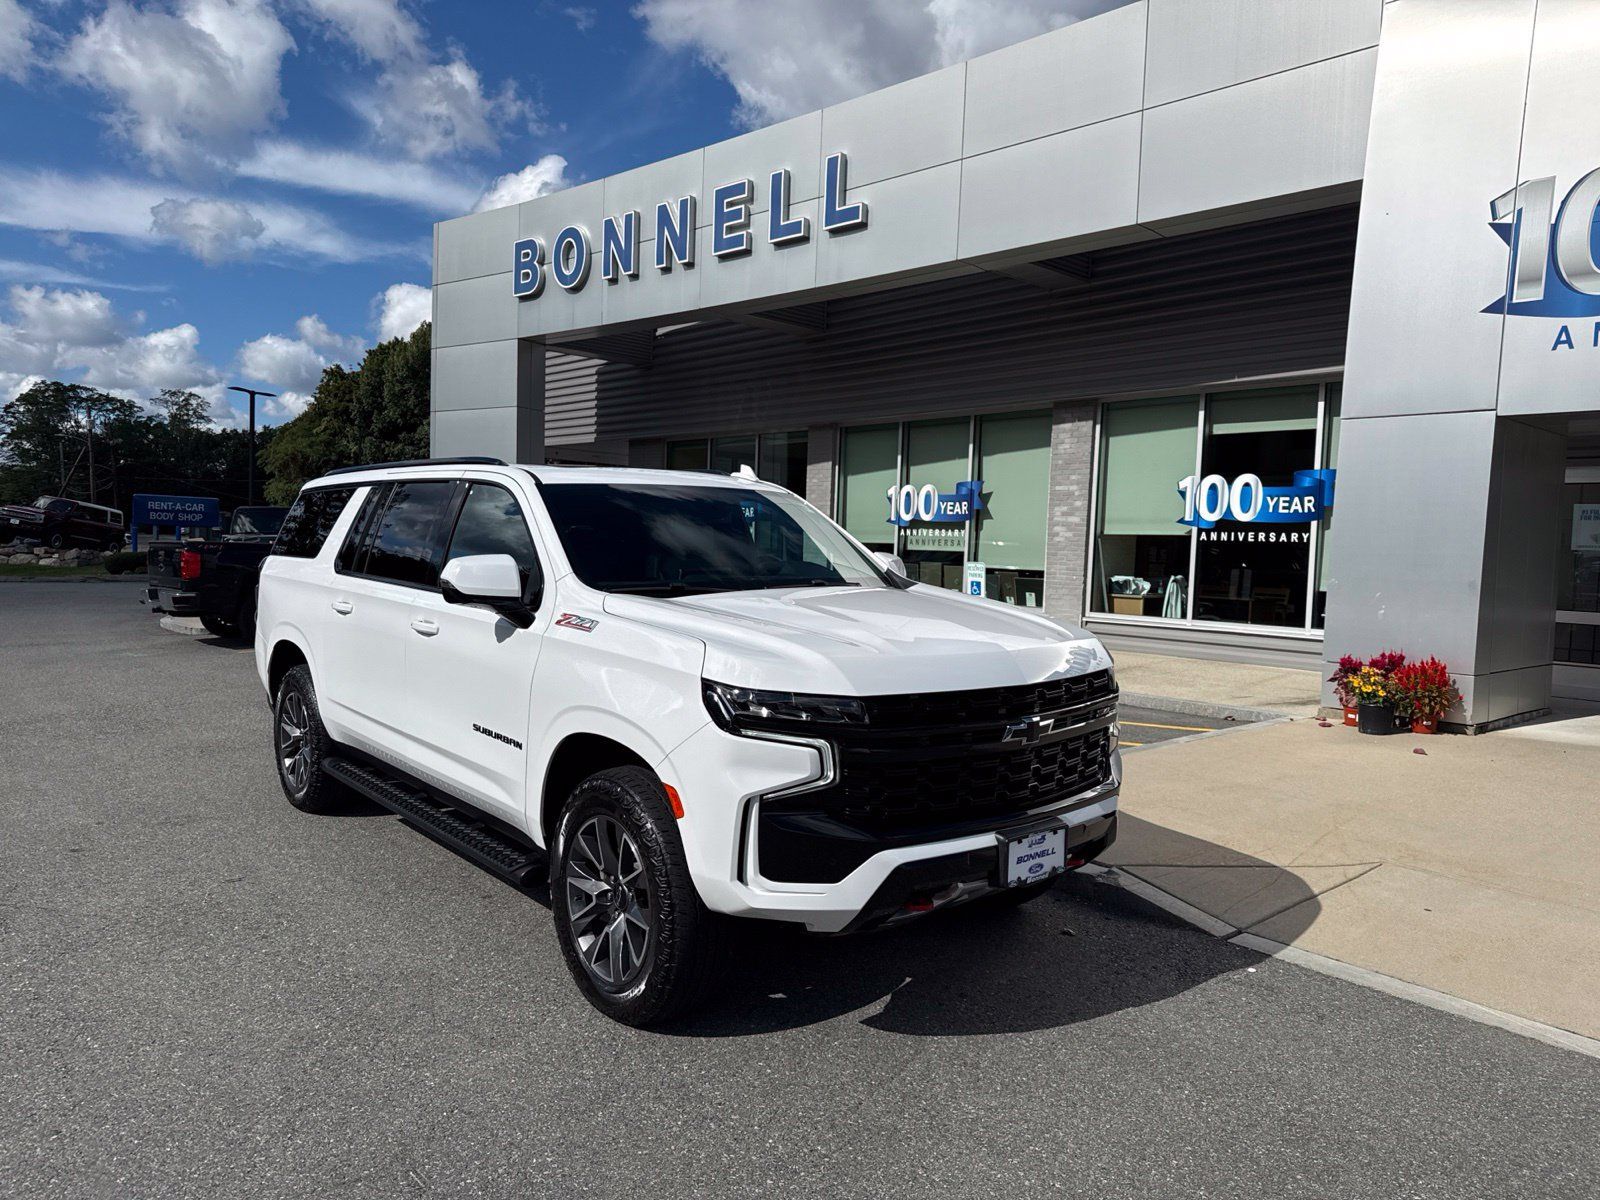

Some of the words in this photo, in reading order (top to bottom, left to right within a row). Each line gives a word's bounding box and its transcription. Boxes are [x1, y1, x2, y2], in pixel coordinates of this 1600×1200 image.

[513, 151, 867, 298] BONNELL
[887, 484, 938, 521] 100
[940, 501, 969, 514] YEAR
[1178, 473, 1263, 522] 100
[1266, 496, 1315, 513] YEAR
[148, 501, 205, 511] RENT-A-CAR
[150, 512, 175, 520] BODY
[178, 513, 203, 522] SHOP
[900, 528, 965, 537] ANNIVERSARY
[1200, 532, 1310, 543] ANNIVERSARY
[473, 723, 522, 750] SUBURBAN
[1016, 848, 1056, 864] BONNELL
